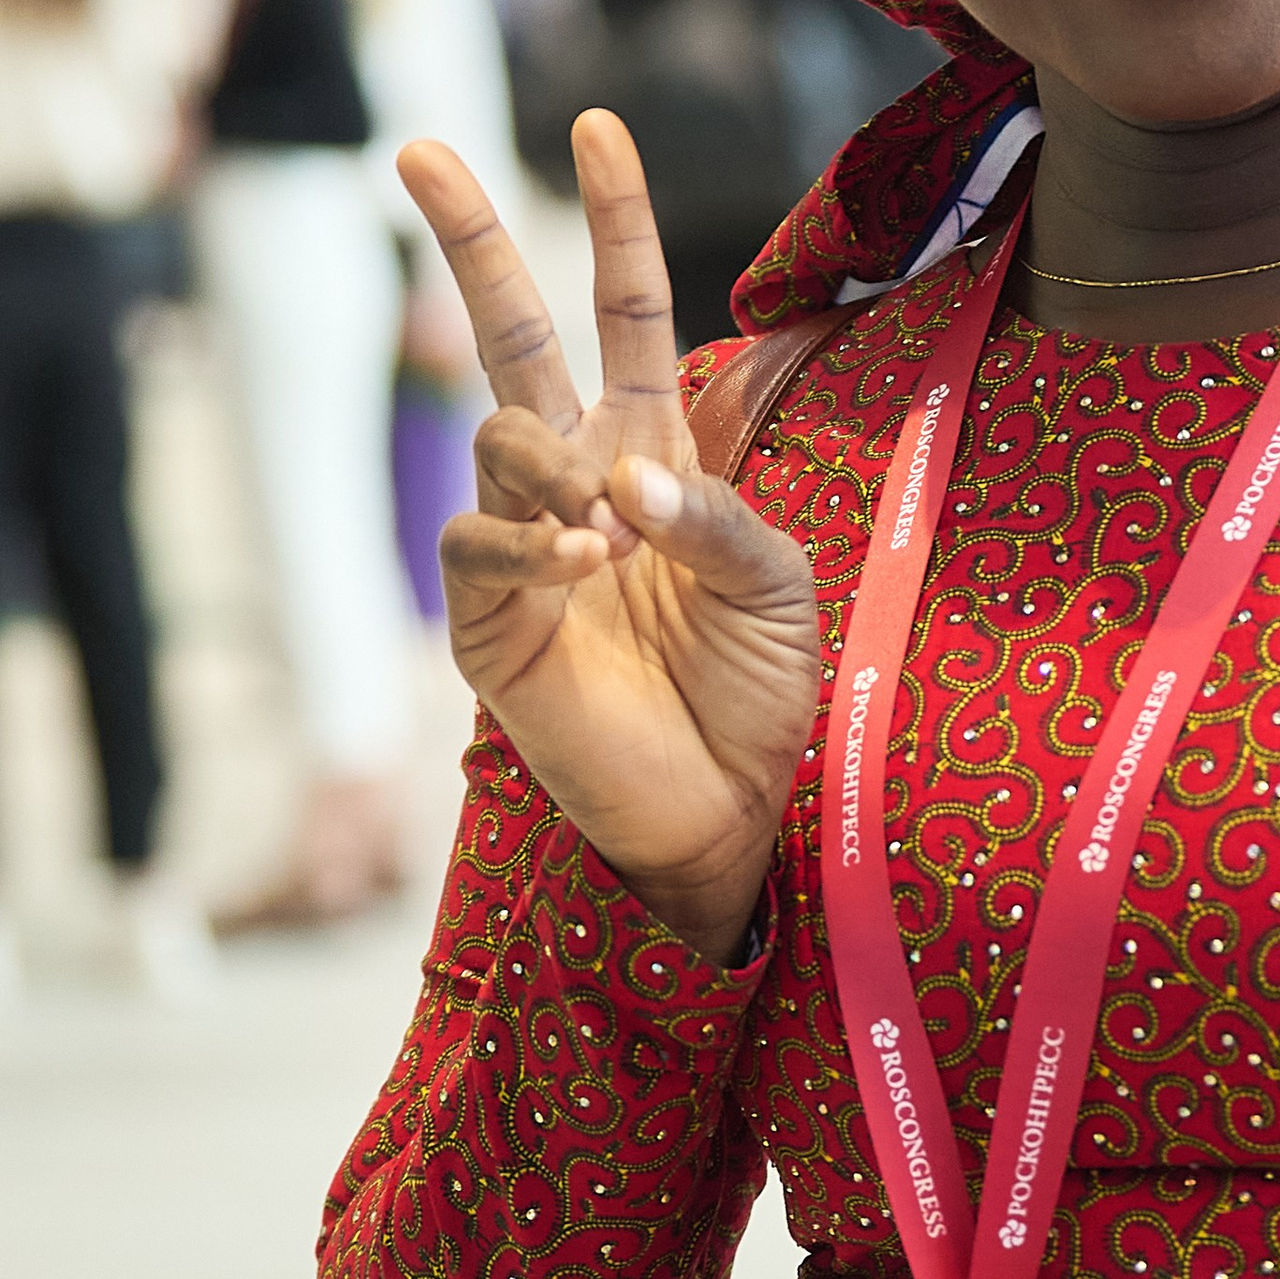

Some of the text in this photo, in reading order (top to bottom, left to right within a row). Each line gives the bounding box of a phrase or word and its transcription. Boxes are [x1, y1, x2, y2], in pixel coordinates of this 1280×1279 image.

[890, 406, 941, 550] ROSCONGRESS
[842, 691, 871, 868] РОСКОНГРЕСС
[1090, 670, 1178, 843] ROSCONGRESS
[881, 1050, 947, 1239] ROSCONGRESS
[1007, 1026, 1066, 1217] РОСКОНГРЕСС
